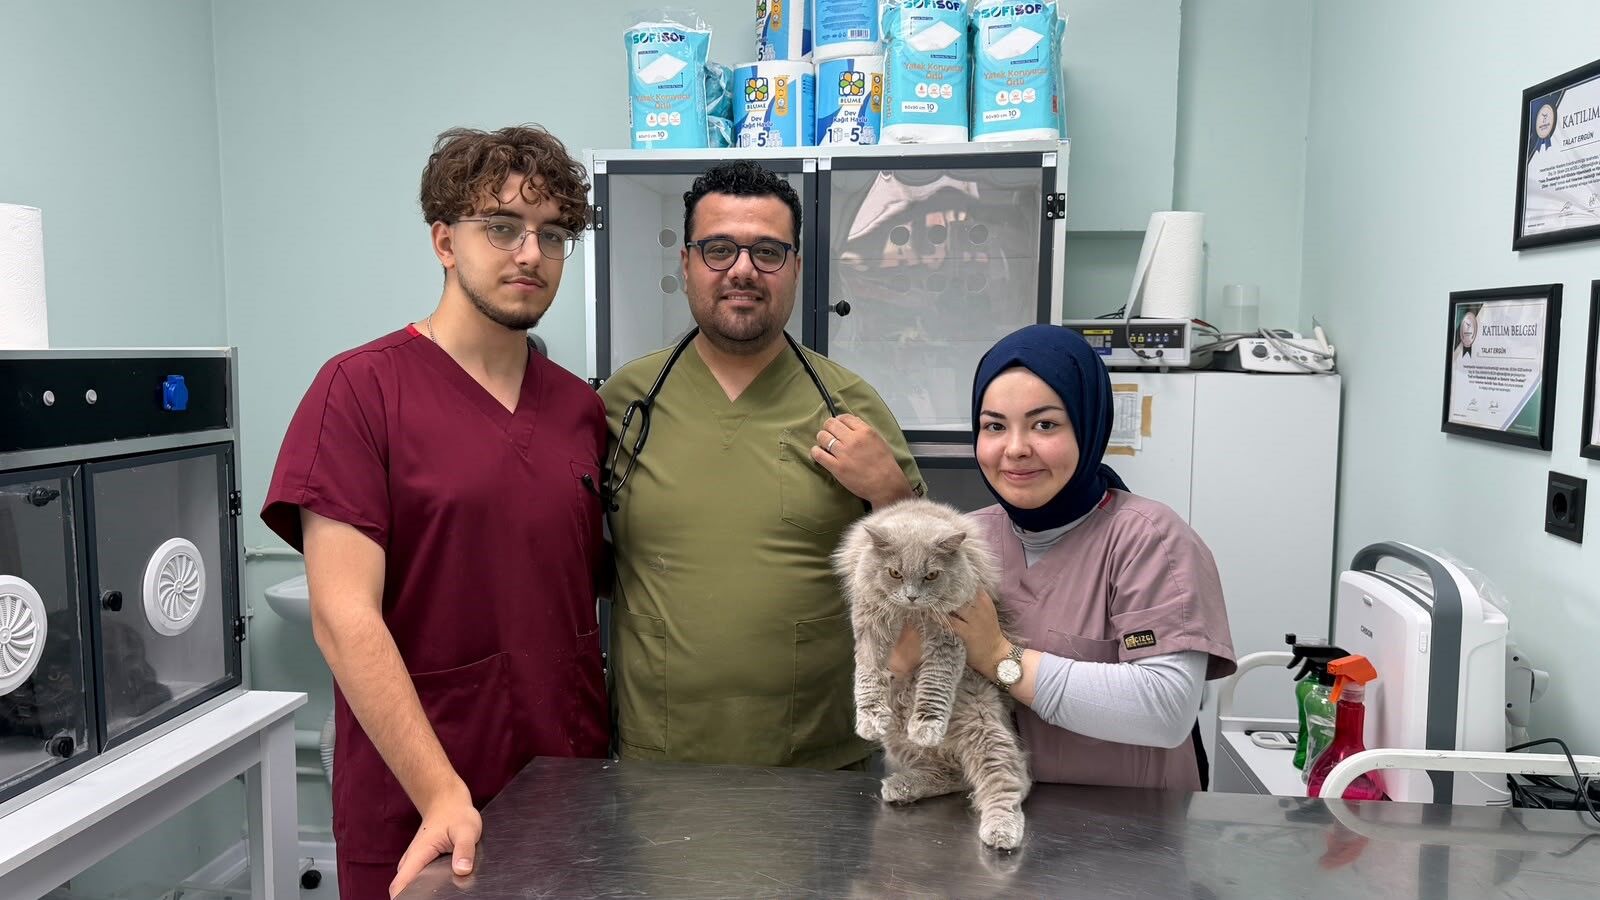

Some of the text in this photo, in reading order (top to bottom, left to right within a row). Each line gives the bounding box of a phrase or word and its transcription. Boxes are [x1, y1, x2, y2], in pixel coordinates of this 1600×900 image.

[1562, 106, 1600, 129] KATILIM
[757, 132, 767, 147] 5
[828, 128, 860, 143] 1 5
[1562, 136, 1578, 146] TALAT
[1482, 325, 1510, 336] KATILIM
